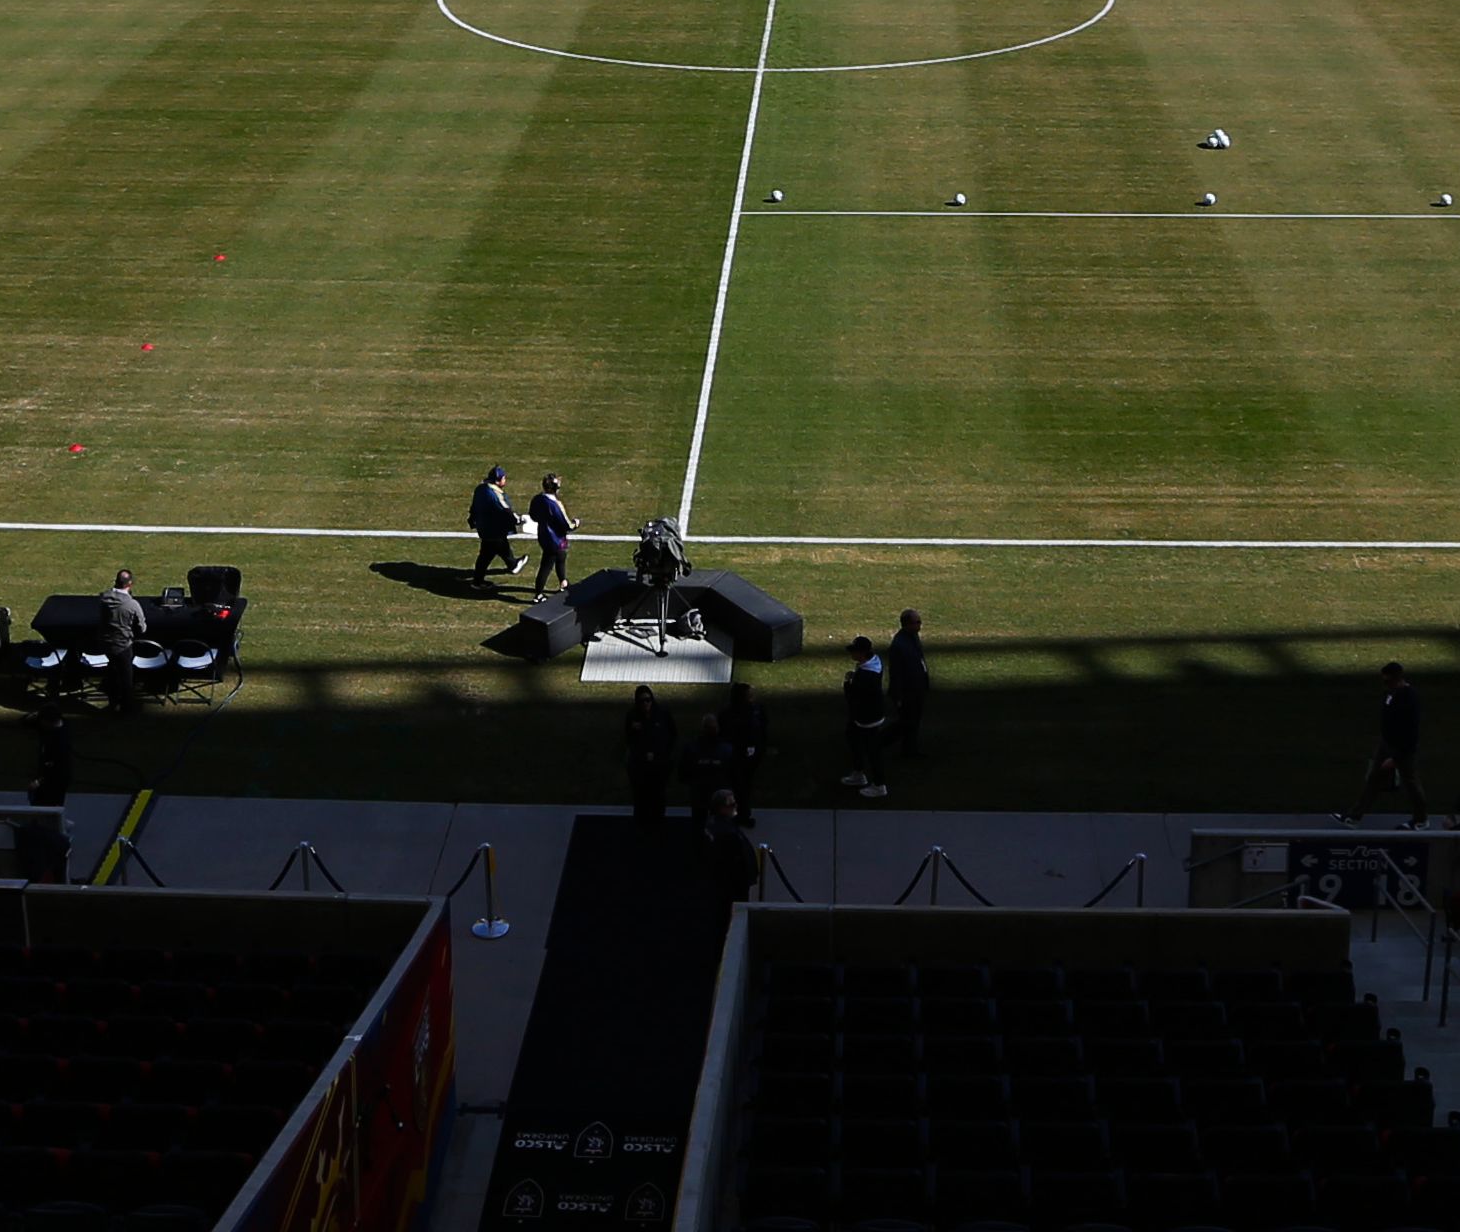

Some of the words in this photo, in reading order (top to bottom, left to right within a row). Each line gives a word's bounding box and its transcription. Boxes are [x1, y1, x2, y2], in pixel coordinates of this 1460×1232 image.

[1328, 859, 1390, 872] SECTION
[1374, 874, 1421, 906] 18
[513, 1139, 570, 1151] ALSCO
[623, 1143, 676, 1153] ALSCO
